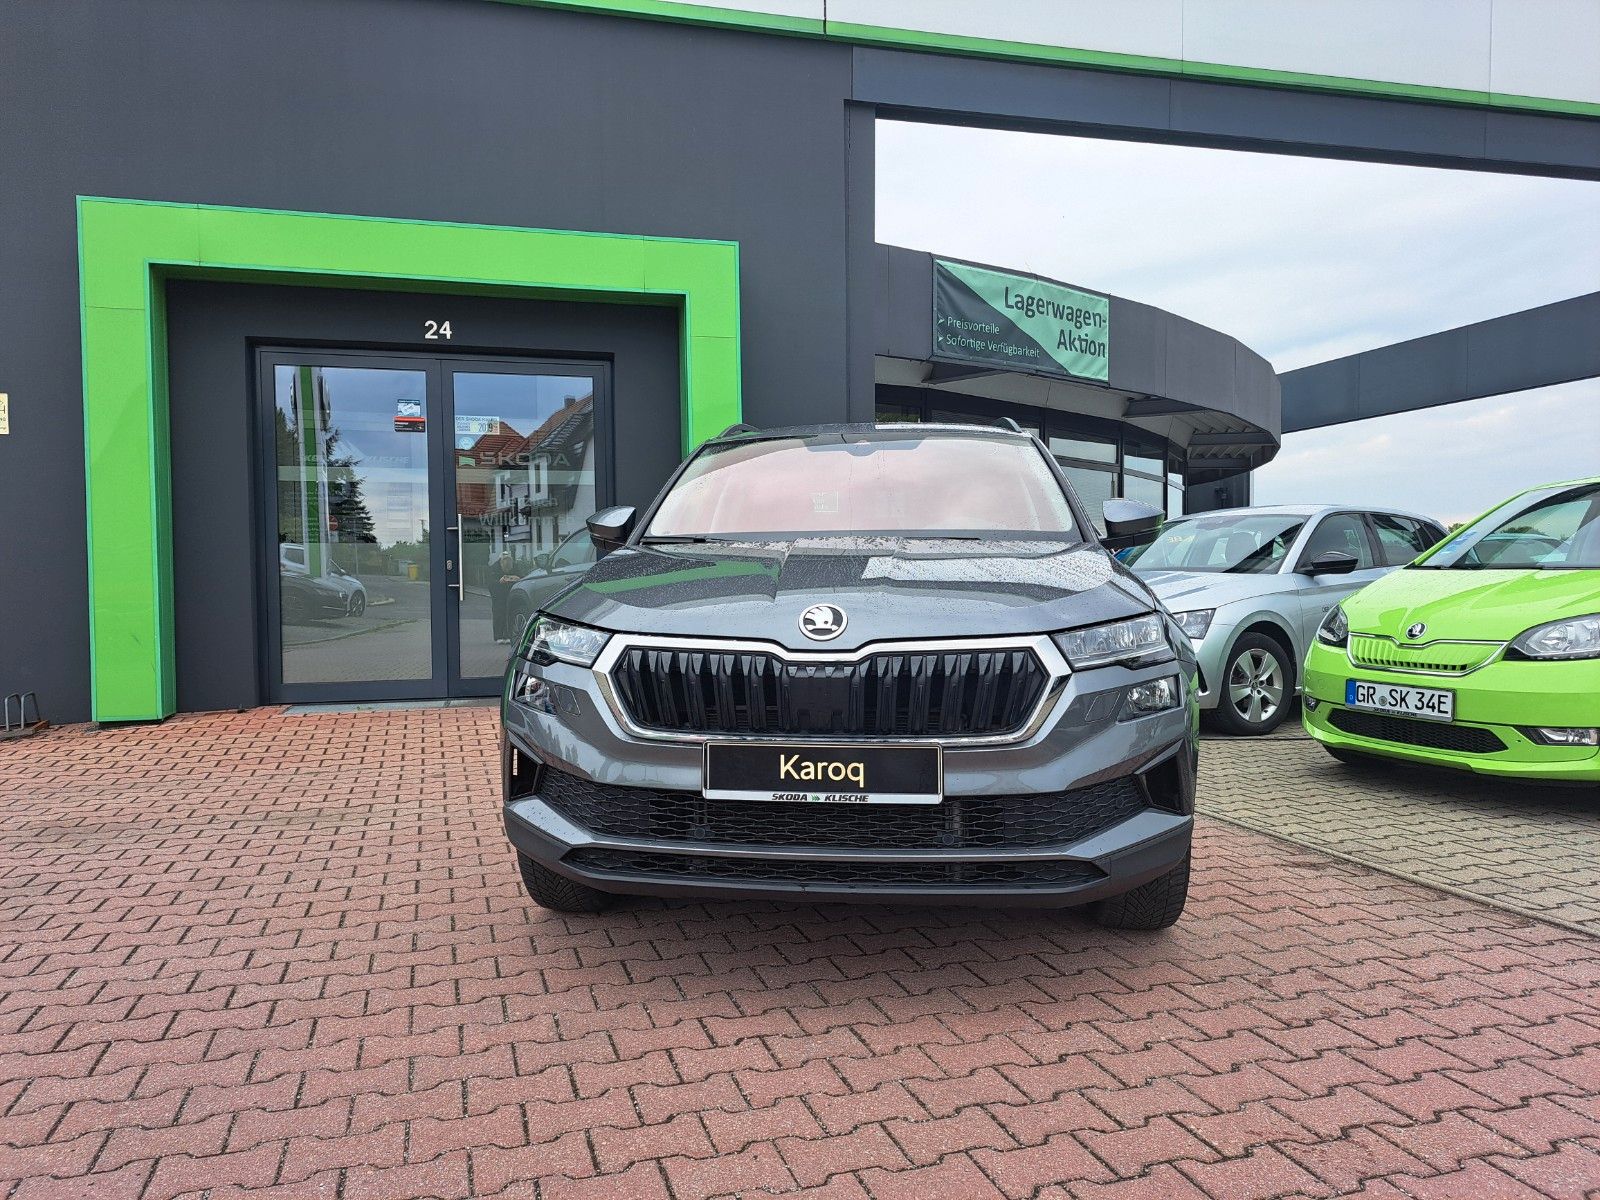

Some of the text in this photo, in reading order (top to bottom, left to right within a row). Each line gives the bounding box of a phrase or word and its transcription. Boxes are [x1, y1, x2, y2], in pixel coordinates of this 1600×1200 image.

[1004, 286, 1107, 329] Lagerwagen-
[424, 319, 453, 340] 24
[947, 316, 1000, 335] Preisvorteile
[946, 334, 1040, 358] Sofortige Verfügbarkeit
[1056, 329, 1106, 358] Aktion
[1356, 685, 1449, 715] GR SK 34E
[779, 754, 865, 788] Karoq
[771, 793, 870, 803] SKODA KLISCHE
